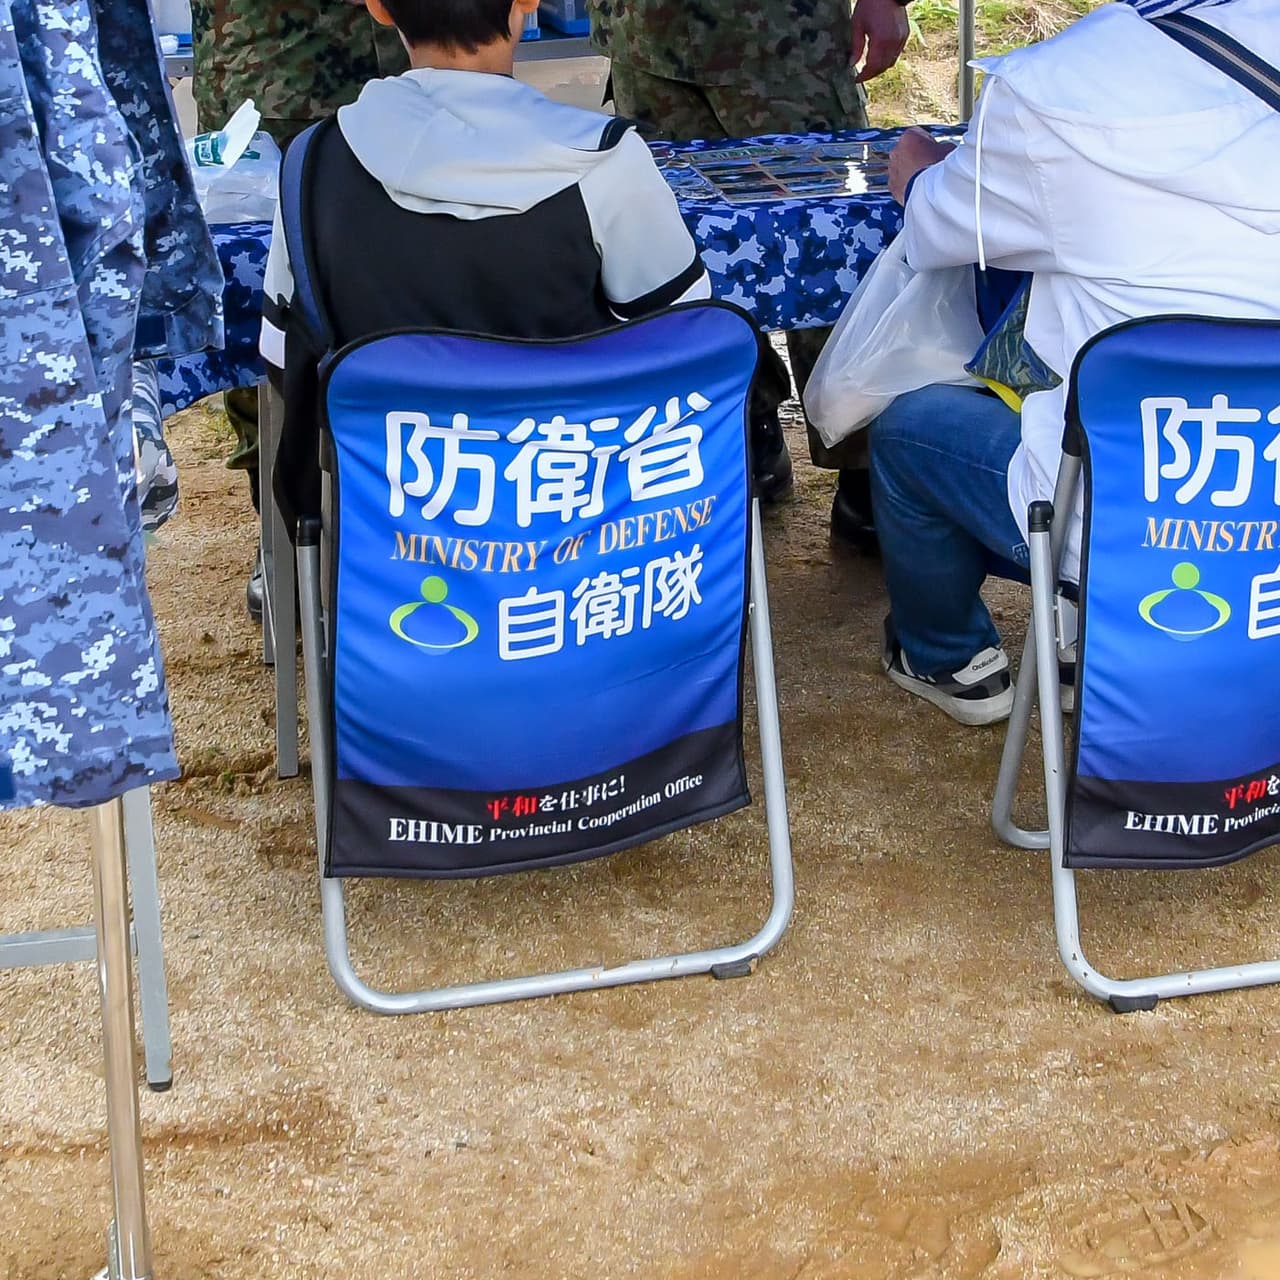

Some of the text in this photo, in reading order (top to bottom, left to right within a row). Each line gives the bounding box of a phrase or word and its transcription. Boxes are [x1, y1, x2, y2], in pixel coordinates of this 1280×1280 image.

[384, 391, 711, 527] 防衛省
[390, 496, 717, 572] MINISTRY OF DEFENSE
[498, 544, 703, 661] 自衛隊
[388, 773, 703, 844] EHIME Provincial Cooperation Office
[1124, 811, 1220, 835] EHIME
